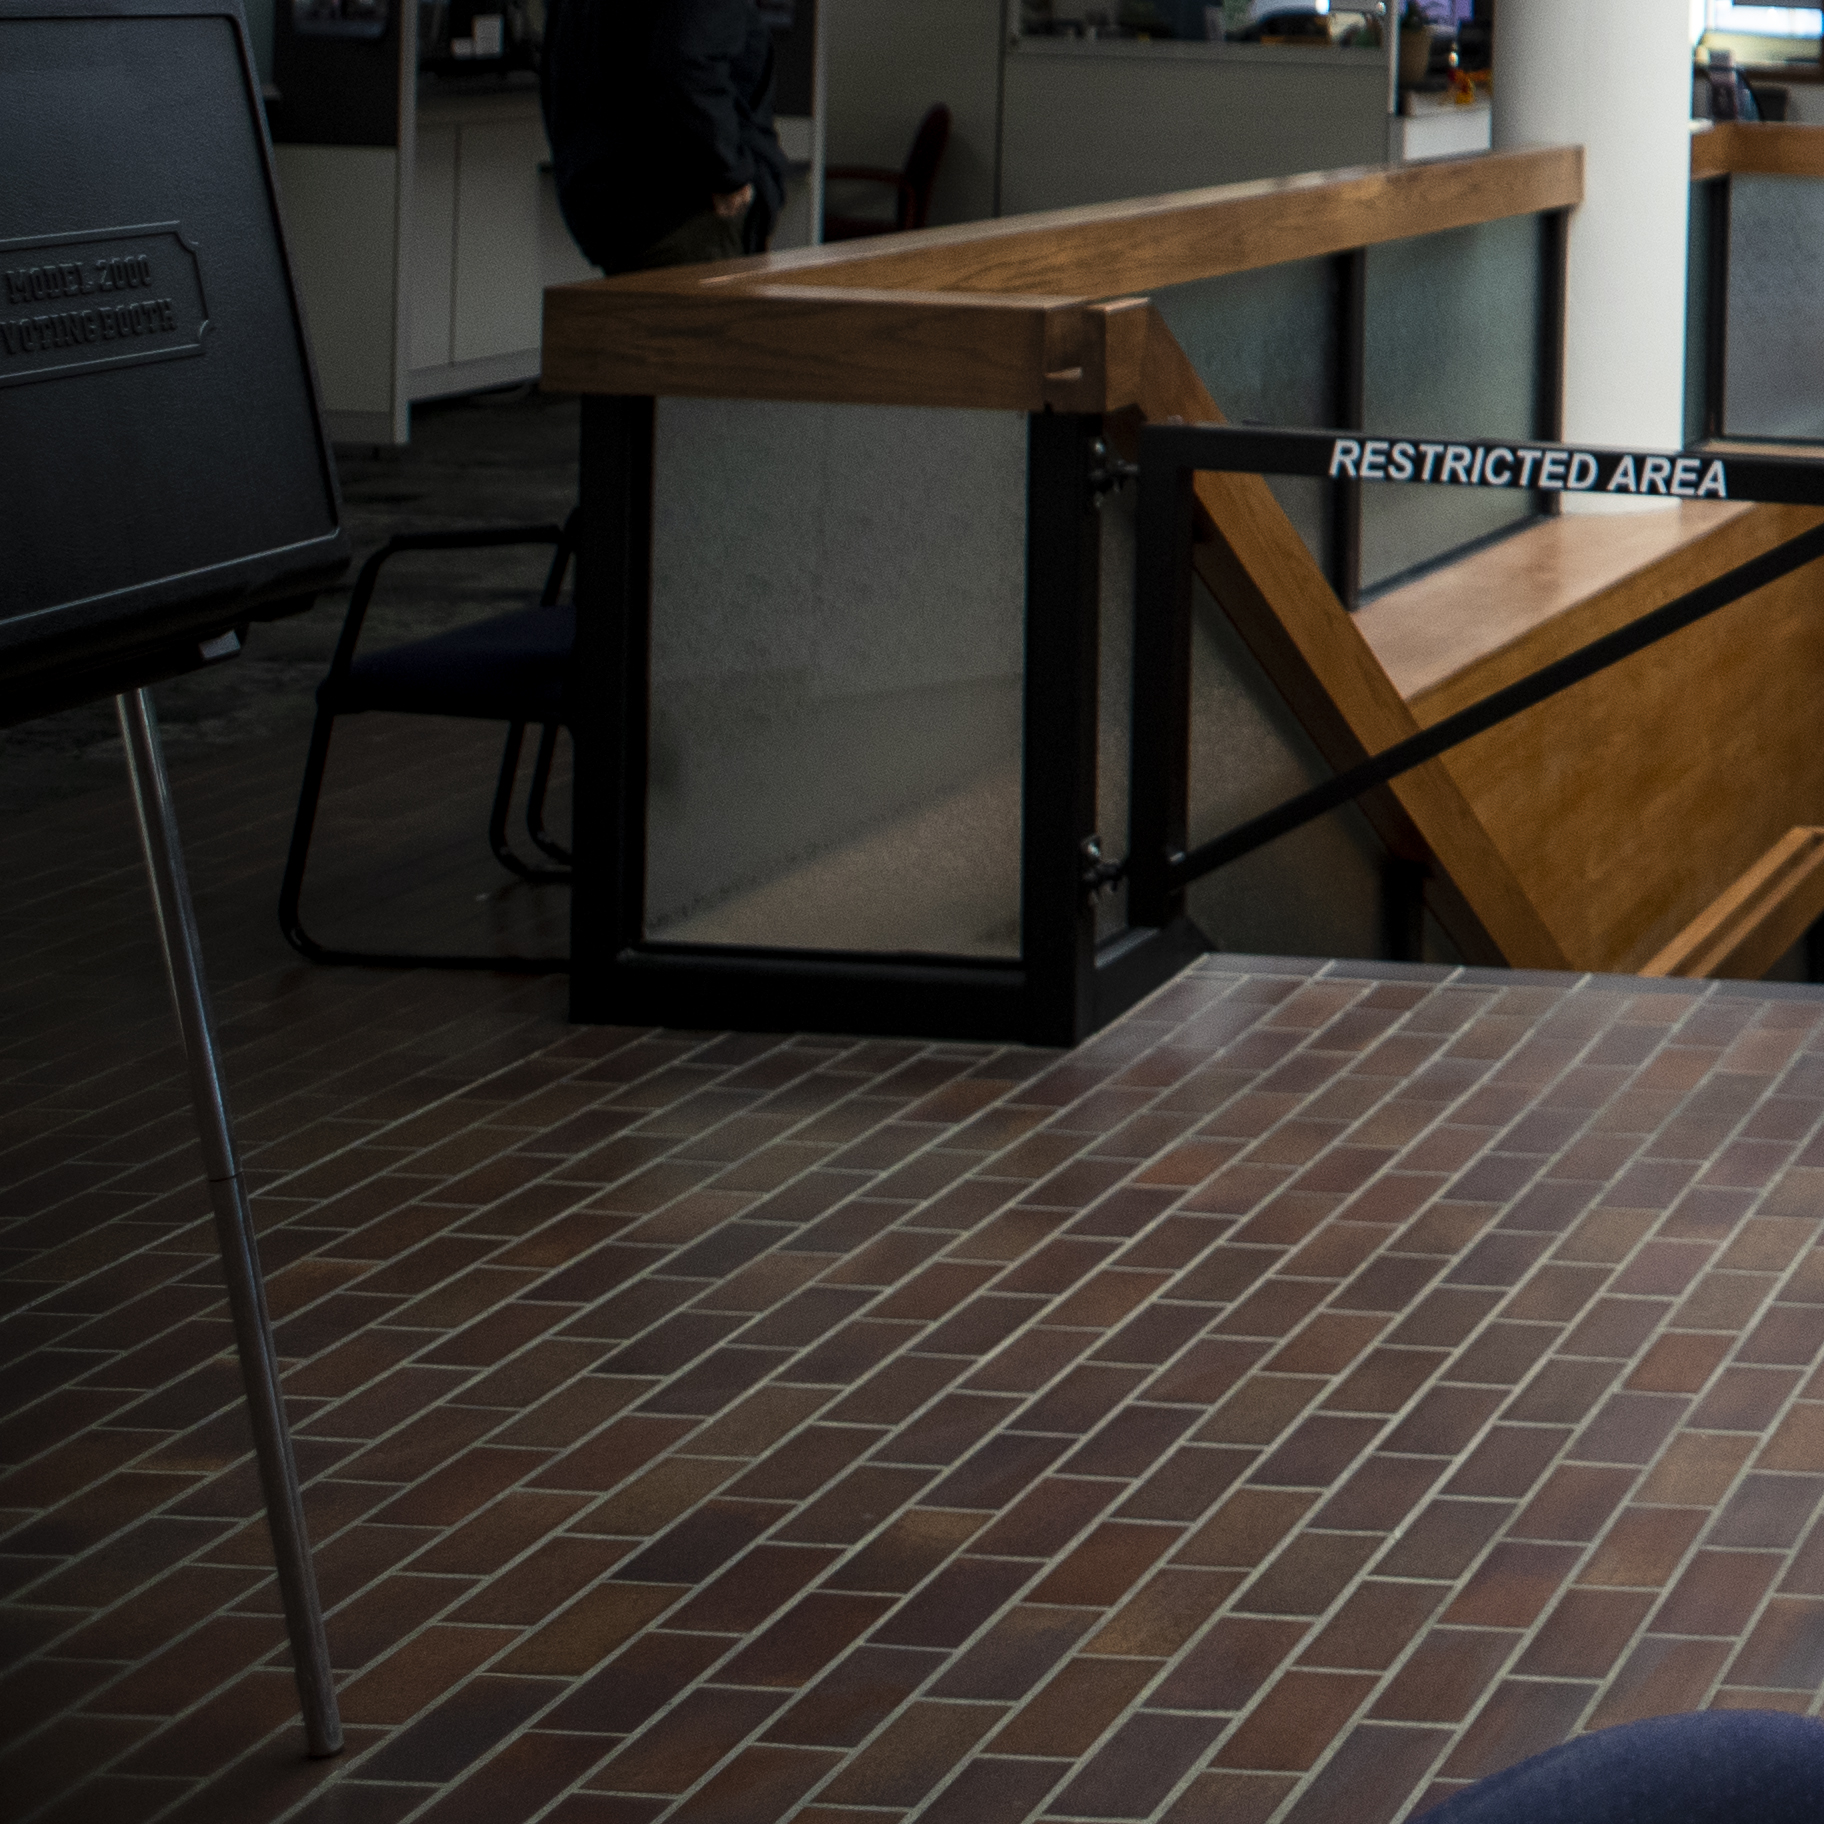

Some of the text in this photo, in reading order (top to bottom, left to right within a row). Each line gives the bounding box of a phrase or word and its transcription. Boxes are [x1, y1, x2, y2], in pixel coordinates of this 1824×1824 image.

[4, 253, 152, 305] MODEL 2000
[0, 297, 178, 356] VOTING BOOTH
[1328, 437, 1728, 499] RESTRICTED AREA
